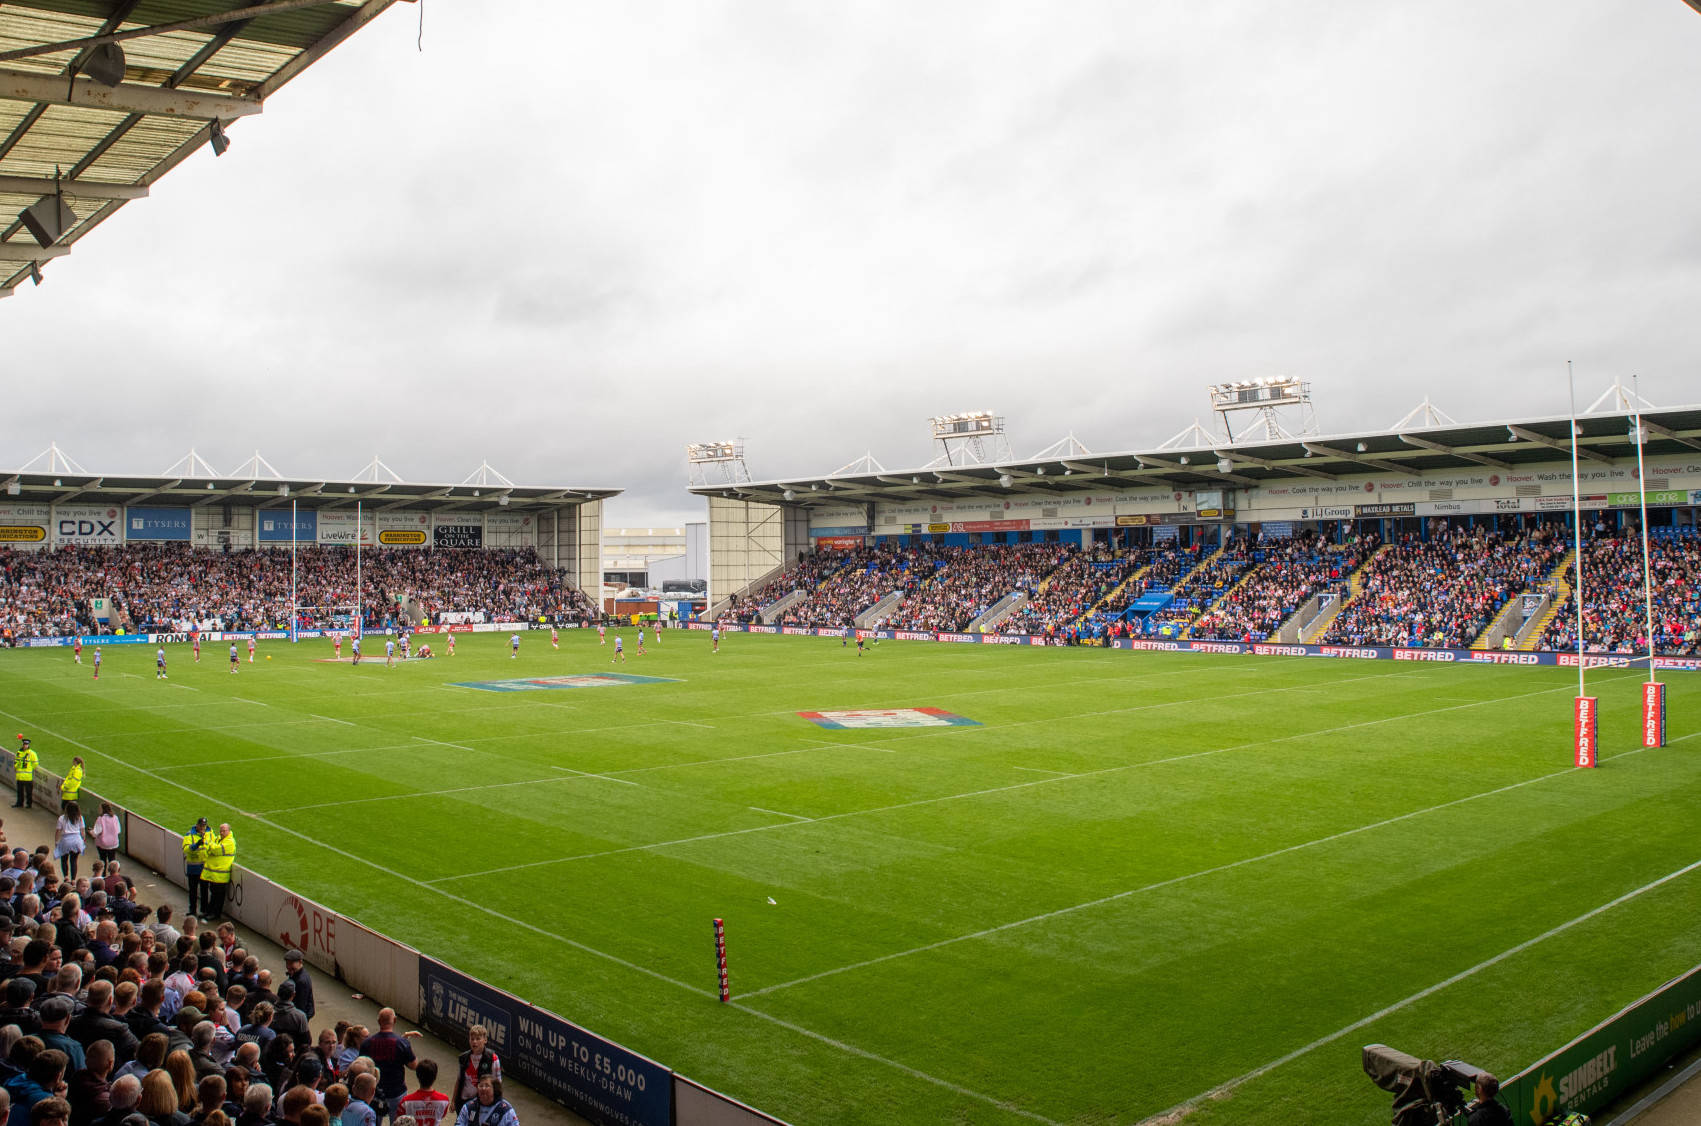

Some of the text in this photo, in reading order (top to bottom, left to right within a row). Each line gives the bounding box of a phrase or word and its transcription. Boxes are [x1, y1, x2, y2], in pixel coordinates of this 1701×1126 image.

[1652, 465, 1701, 475] Hoover. Cle
[1537, 473, 1557, 481] Wash
[1559, 472, 1571, 480] the
[1591, 472, 1606, 480] you
[1407, 479, 1423, 487] Chill
[1424, 479, 1436, 487] the
[1292, 487, 1307, 495] Cook
[1324, 507, 1351, 518] Group
[59, 520, 115, 536] CDX
[147, 520, 187, 528] TYSERS
[438, 526, 476, 534] GRILL
[58, 537, 117, 545] SECURITY
[321, 530, 357, 540] LiveWire
[434, 539, 481, 548] SQUARE
[896, 632, 929, 641] BETFRED
[939, 633, 973, 642] BETFRED
[1133, 640, 1178, 651] BETFRED
[1193, 641, 1240, 653] BETFRED
[1255, 644, 1306, 656] BETFRED
[1322, 646, 1378, 659] BETFRED
[1395, 649, 1455, 662] BETFRED
[1473, 652, 1539, 665] BETFRED
[1559, 655, 1630, 668] BETFRED
[1647, 685, 1656, 746] BETFRED
[1579, 699, 1590, 766] BETFRED
[719, 926, 729, 995] BETFRED
[448, 999, 507, 1046] LIFELINE
[1630, 1031, 1655, 1059] Leave
[1656, 1019, 1669, 1042] the
[1670, 1010, 1687, 1033] how
[1687, 1003, 1695, 1021] to
[519, 1015, 646, 1091] WIN UP TO £5,000
[518, 1035, 633, 1102] ON OUR WEEKLY DRAW
[1559, 1045, 1617, 1105] SUNBELT
[1568, 1076, 1609, 1110] RENTALS
